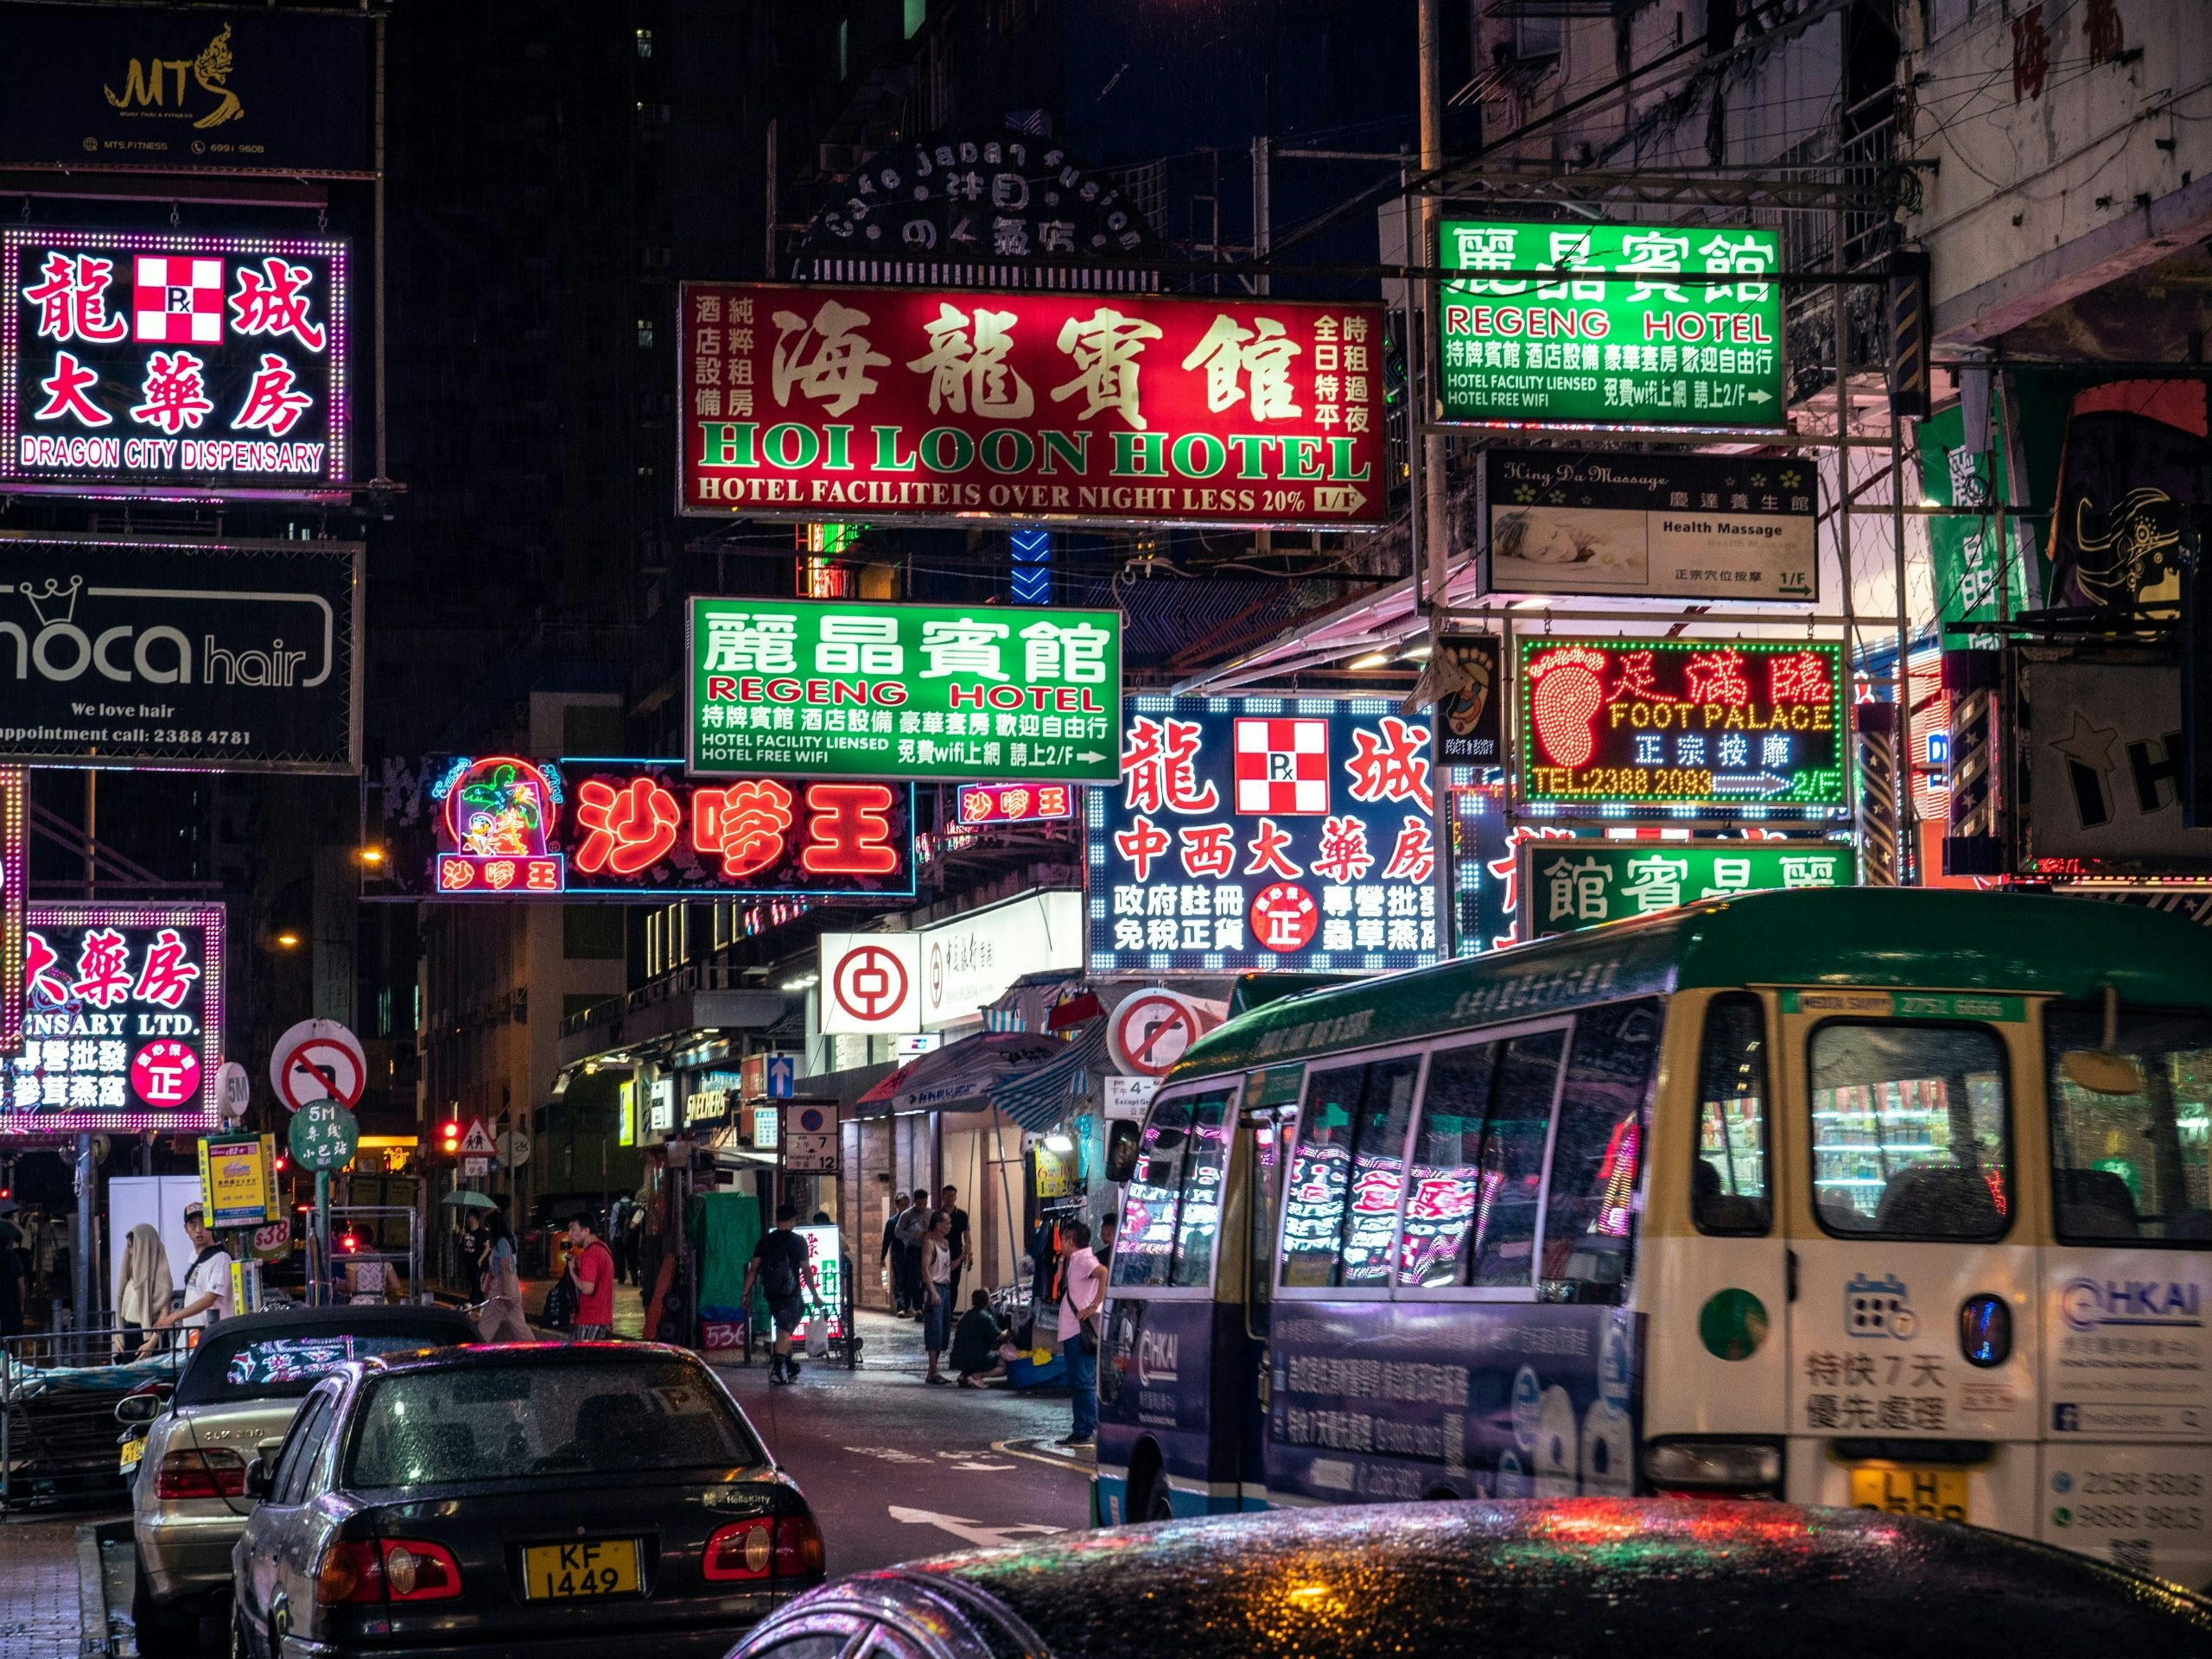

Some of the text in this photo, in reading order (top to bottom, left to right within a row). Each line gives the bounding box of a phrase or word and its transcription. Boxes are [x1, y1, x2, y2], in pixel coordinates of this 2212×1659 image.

[104, 22, 245, 129] MTS
[104, 141, 168, 151] MTS.FITNESS
[23, 251, 128, 344] 龍
[228, 258, 327, 353] 城
[1446, 304, 1773, 345] REGENG HOTEL
[695, 295, 721, 416] 酒店設備
[772, 299, 1302, 431] 海龍賓館
[1313, 314, 1341, 431] 全日特平
[1446, 339, 1521, 370] 持牌賓館
[1525, 341, 1600, 372] 酒店設備
[1604, 344, 1677, 373] 豪華套房
[1343, 315, 1370, 434] 時租過夜
[1447, 374, 1597, 391] HOTEL FACILITY LIENSED
[35, 351, 313, 437] 大藥房
[1447, 391, 1549, 407] HOTEL FREE WIFI
[21, 436, 324, 473] DRAGON CITY DISPENSARY
[698, 421, 1372, 483] HOI LOON HOTEL
[697, 477, 1306, 513] HOTEL FACILITEIS OVER NIGHT LESS 20%
[1587, 465, 1669, 492] Massage
[1319, 490, 1359, 510] 1/F
[1663, 520, 1783, 537] Health Massage
[1780, 570, 1806, 586] 1/F
[204, 634, 306, 688] hair
[703, 611, 1111, 684] 麗晶賓館
[71, 702, 175, 719] We love hair
[707, 675, 1105, 714] REGENG HOTEL
[701, 703, 1108, 741] 持牌賓館 酒店設備 豪華套房 歡迎自由行
[1608, 702, 1835, 732] FOOT PALACE
[112, 728, 150, 743] call:
[154, 728, 203, 744] 2388
[207, 730, 251, 745] 4781
[702, 733, 889, 751] HOTEL FACILITY LIENSED
[1634, 733, 1791, 768] 正宗按摩
[702, 748, 829, 764] HOTEL FREE WIFI
[1122, 715, 1220, 815] 龍
[1654, 766, 1713, 797] 2093
[1114, 815, 1434, 885] 中西大藥房
[1114, 884, 1245, 918] 政府註冊
[1114, 918, 1245, 951] 免稅正貨
[1266, 910, 1302, 945] 正
[137, 1014, 200, 1036] LTD.
[147, 1066, 183, 1101] 正
[308, 1106, 334, 1122] 5M
[685, 1090, 727, 1122] SKECHERS
[818, 1136, 827, 1148] 7
[819, 1156, 835, 1169] 12
[255, 1222, 289, 1249] $38
[560, 1543, 602, 1570] KF
[547, 1567, 620, 1598] 1449
